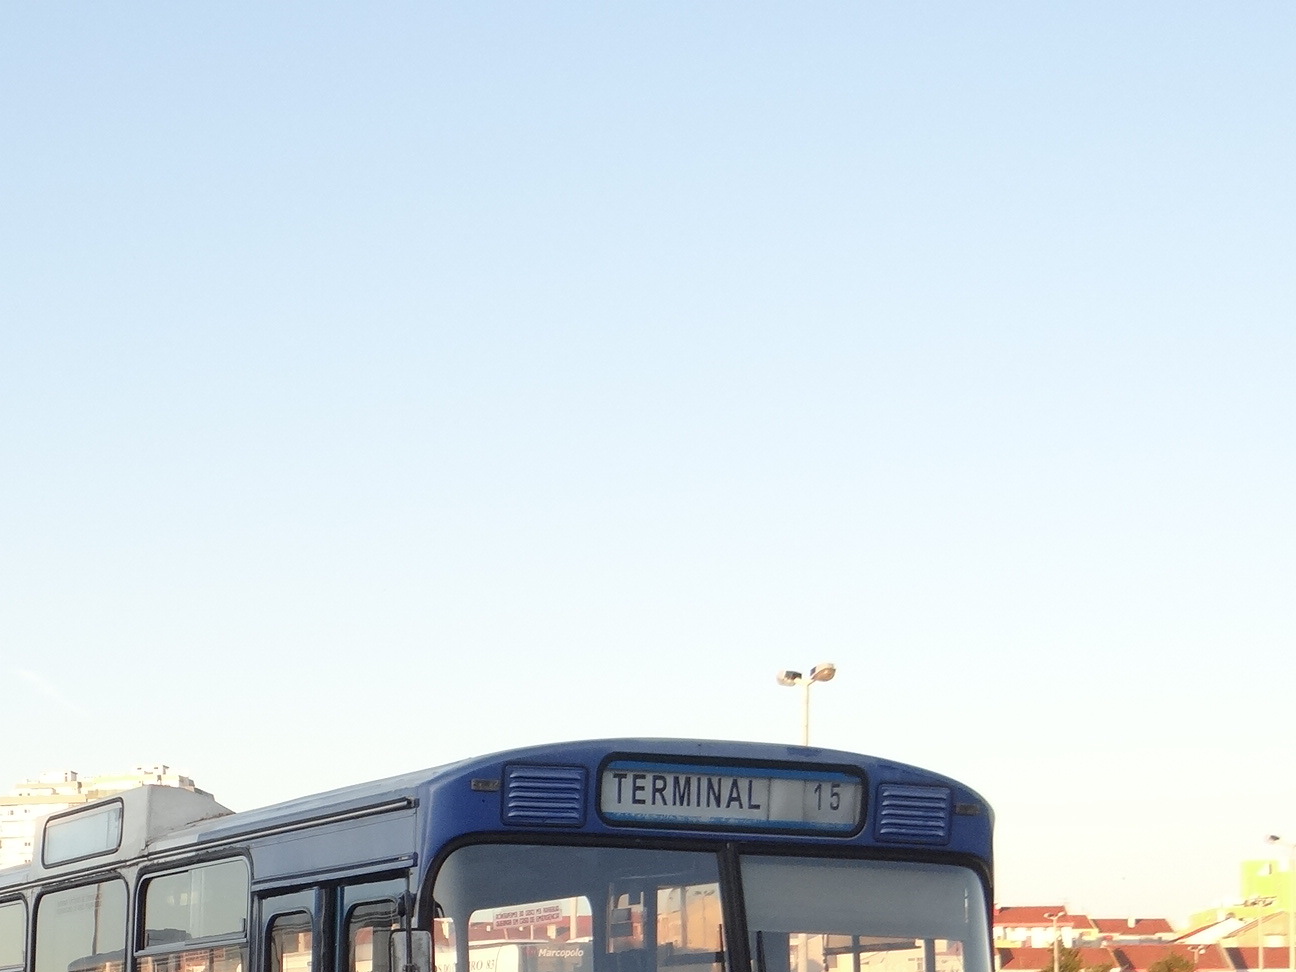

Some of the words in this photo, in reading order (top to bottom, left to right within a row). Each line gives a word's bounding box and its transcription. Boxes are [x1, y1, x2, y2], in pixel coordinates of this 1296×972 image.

[612, 773, 761, 811] TERMINAL
[813, 782, 841, 811] 15
[538, 948, 584, 958] Marcopolo
